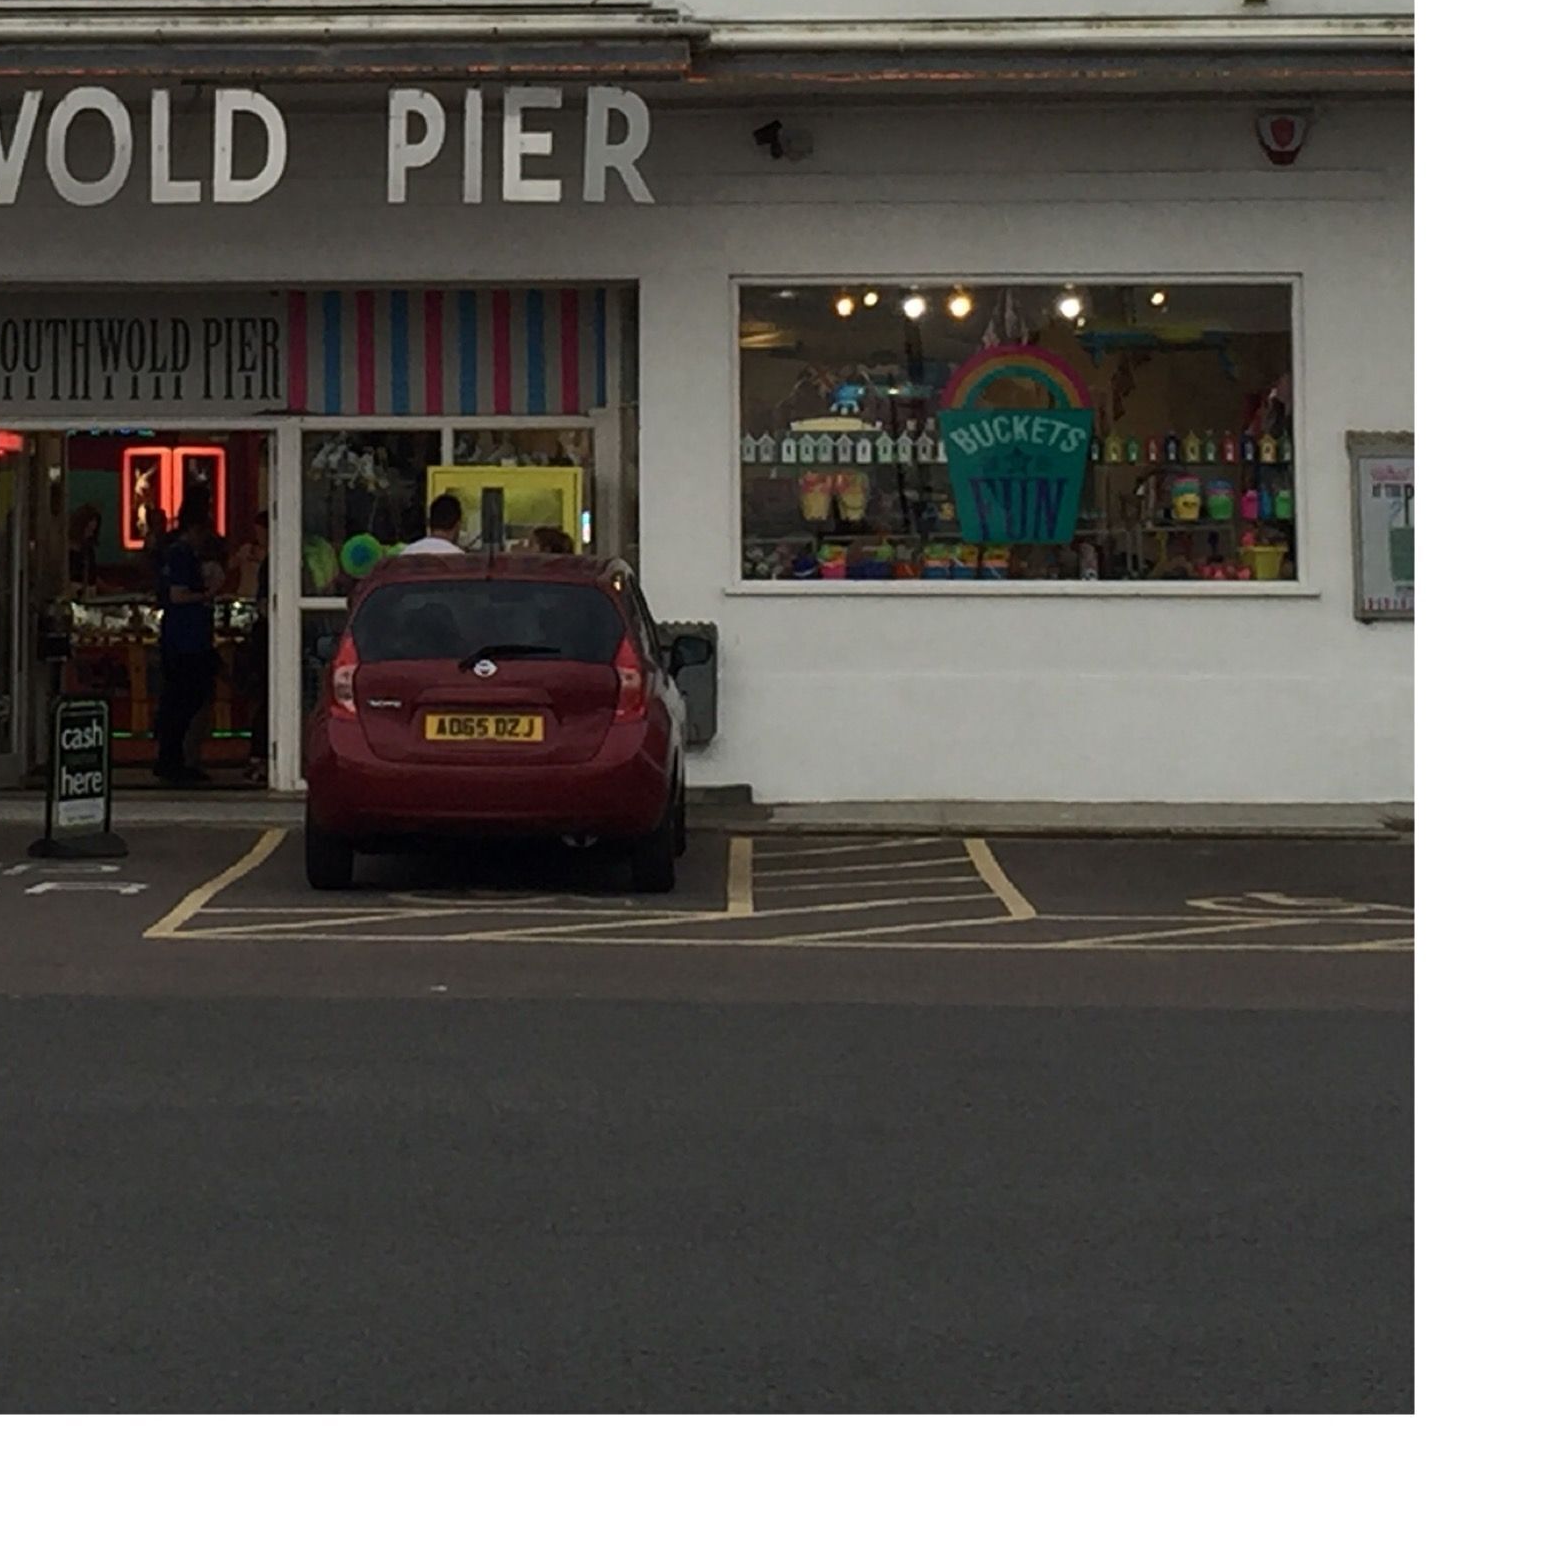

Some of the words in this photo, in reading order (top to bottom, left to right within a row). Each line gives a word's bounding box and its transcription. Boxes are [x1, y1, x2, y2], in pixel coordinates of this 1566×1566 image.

[387, 85, 655, 203] PIER
[203, 317, 281, 401] PIER
[949, 414, 1087, 455] BUCKETS
[969, 476, 1069, 541] FUN
[61, 718, 103, 750] cash
[495, 717, 534, 737] DZJ
[61, 766, 103, 795] here
